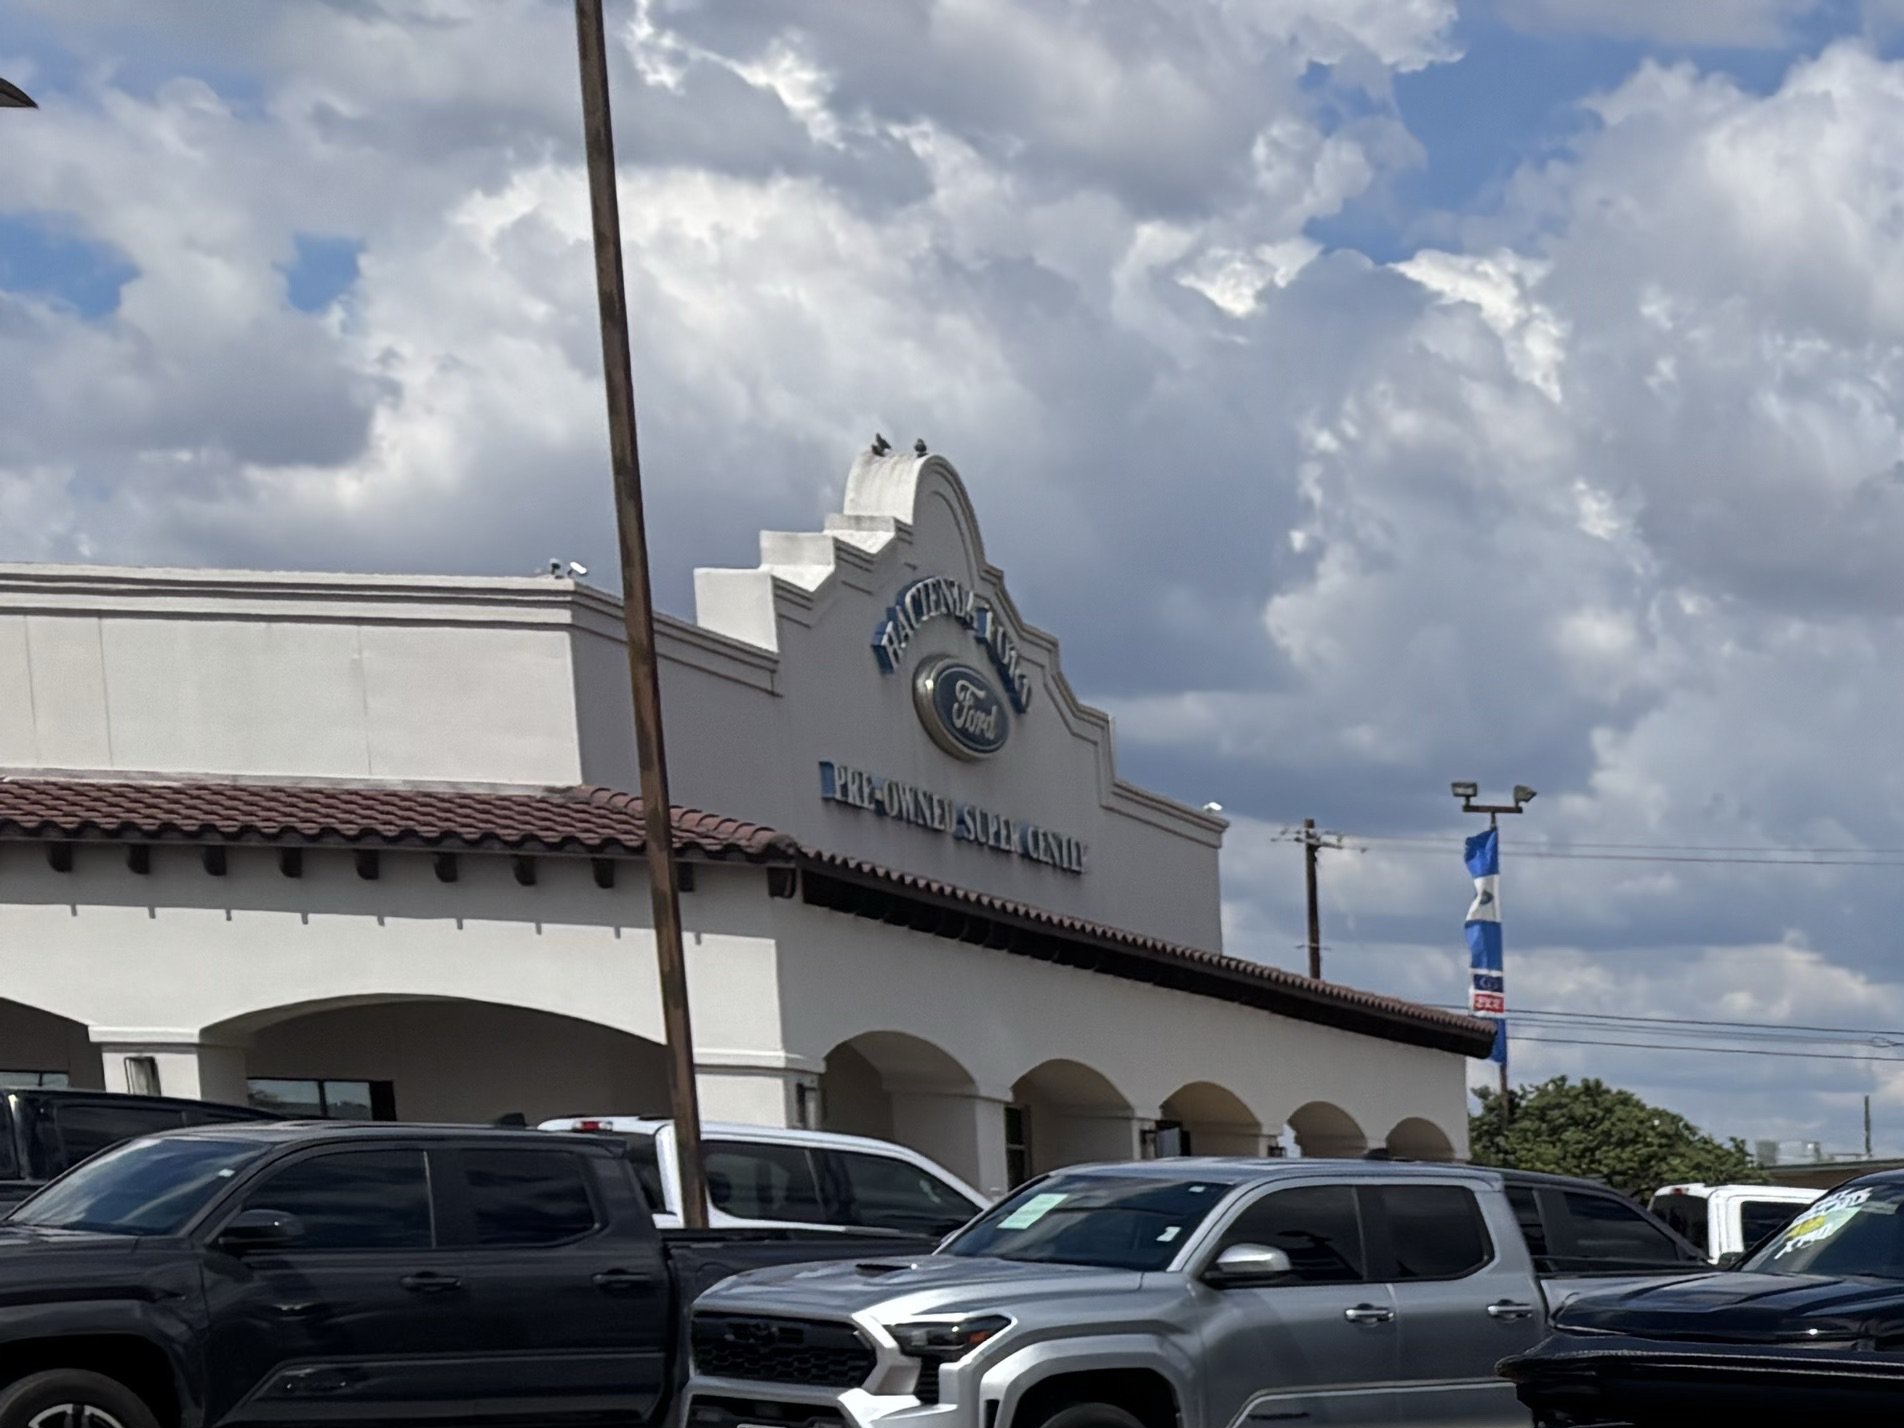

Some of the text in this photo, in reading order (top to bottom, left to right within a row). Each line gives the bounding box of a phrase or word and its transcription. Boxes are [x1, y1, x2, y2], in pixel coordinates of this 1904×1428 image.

[952, 680, 998, 740] Ford
[824, 762, 956, 833] PRE-OWNED
[960, 802, 1020, 853] SUPER
